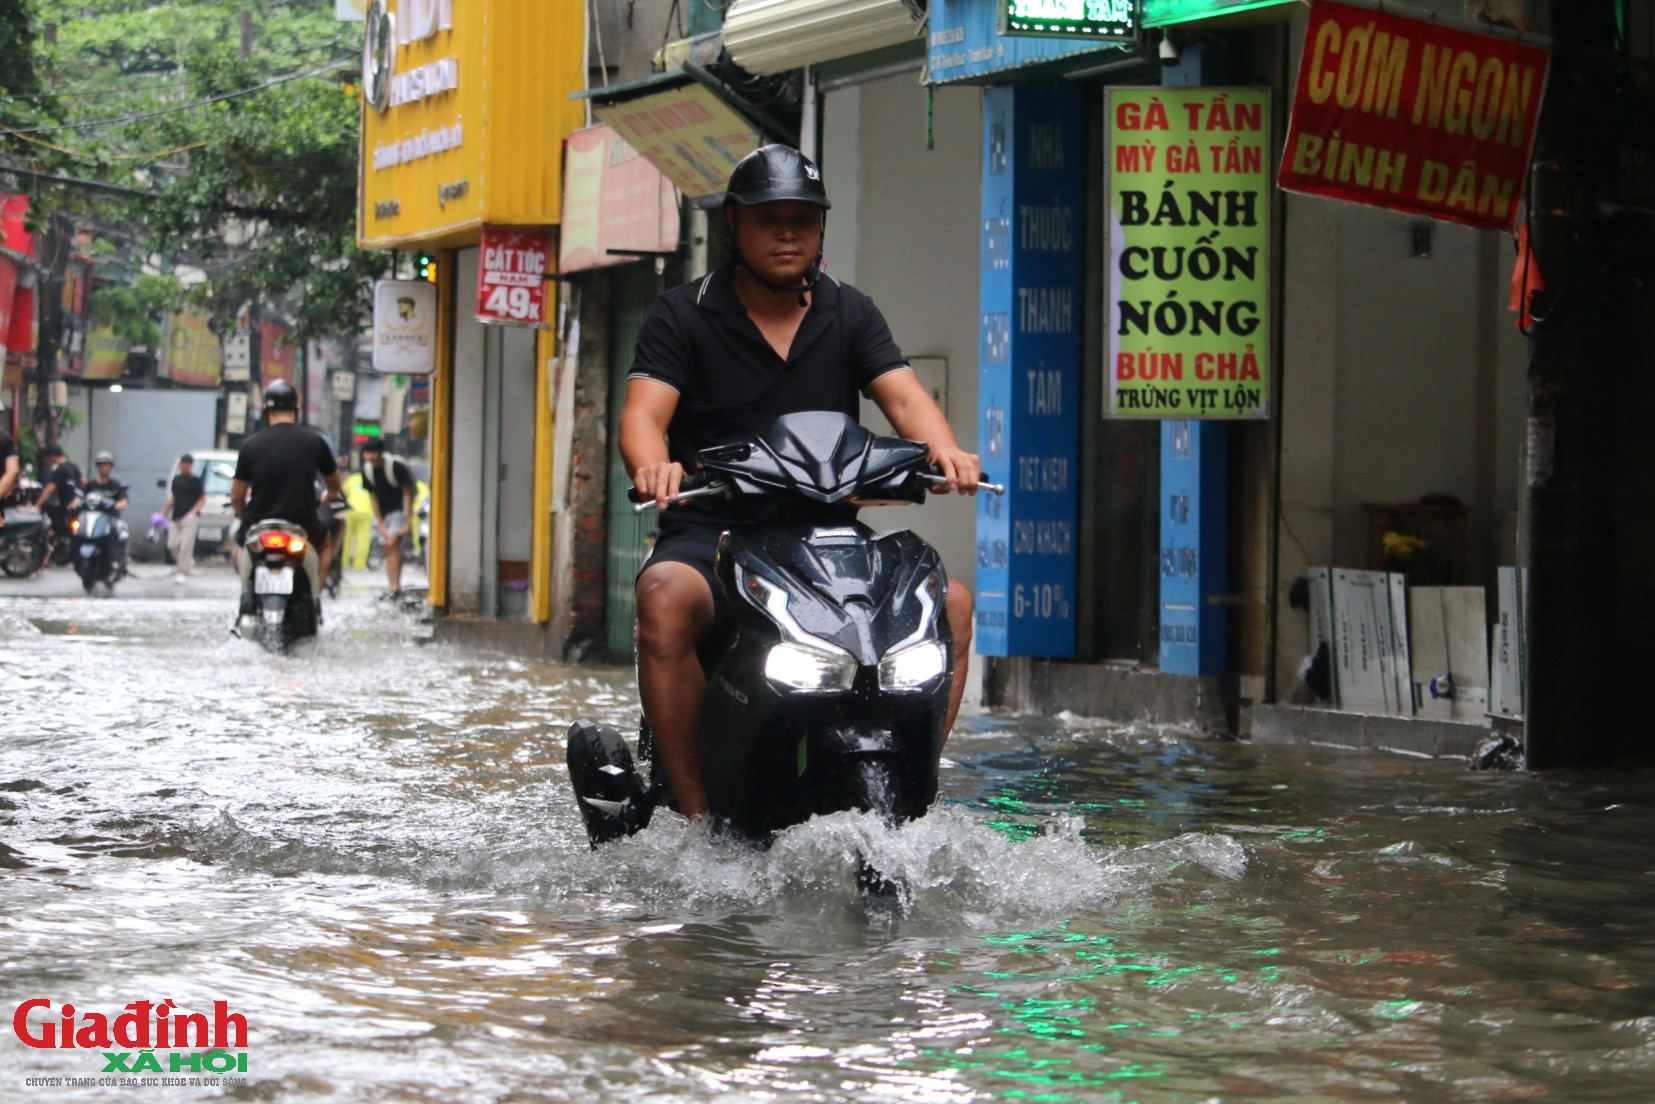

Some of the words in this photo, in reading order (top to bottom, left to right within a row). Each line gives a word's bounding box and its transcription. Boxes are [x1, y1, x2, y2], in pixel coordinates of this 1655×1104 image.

[1308, 19, 1410, 119] CƠM
[1412, 43, 1535, 148] NGON
[1116, 96, 1170, 131] GÀ
[1183, 92, 1262, 131] TẦN
[1116, 138, 1157, 173] MỲ
[1165, 138, 1202, 174] GÀ
[1209, 135, 1262, 174] TẦN
[1292, 130, 1407, 194] BÌNH
[1417, 159, 1514, 217] DÂN
[1118, 179, 1259, 227] BÁNH
[517, 248, 545, 274] TÓC
[1118, 229, 1259, 281] CUỐN
[500, 274, 529, 285] NAM
[485, 286, 540, 320] 49K
[1018, 288, 1072, 333] THANH
[1117, 290, 1261, 337] NÓNG
[1116, 346, 1183, 381] BÚN
[1194, 343, 1261, 381] CHẢ
[1116, 383, 1182, 408] TRỨNG
[1186, 388, 1219, 414] VỊT
[1223, 383, 1261, 414] LỘN
[1013, 583, 1070, 619] 6-10%
